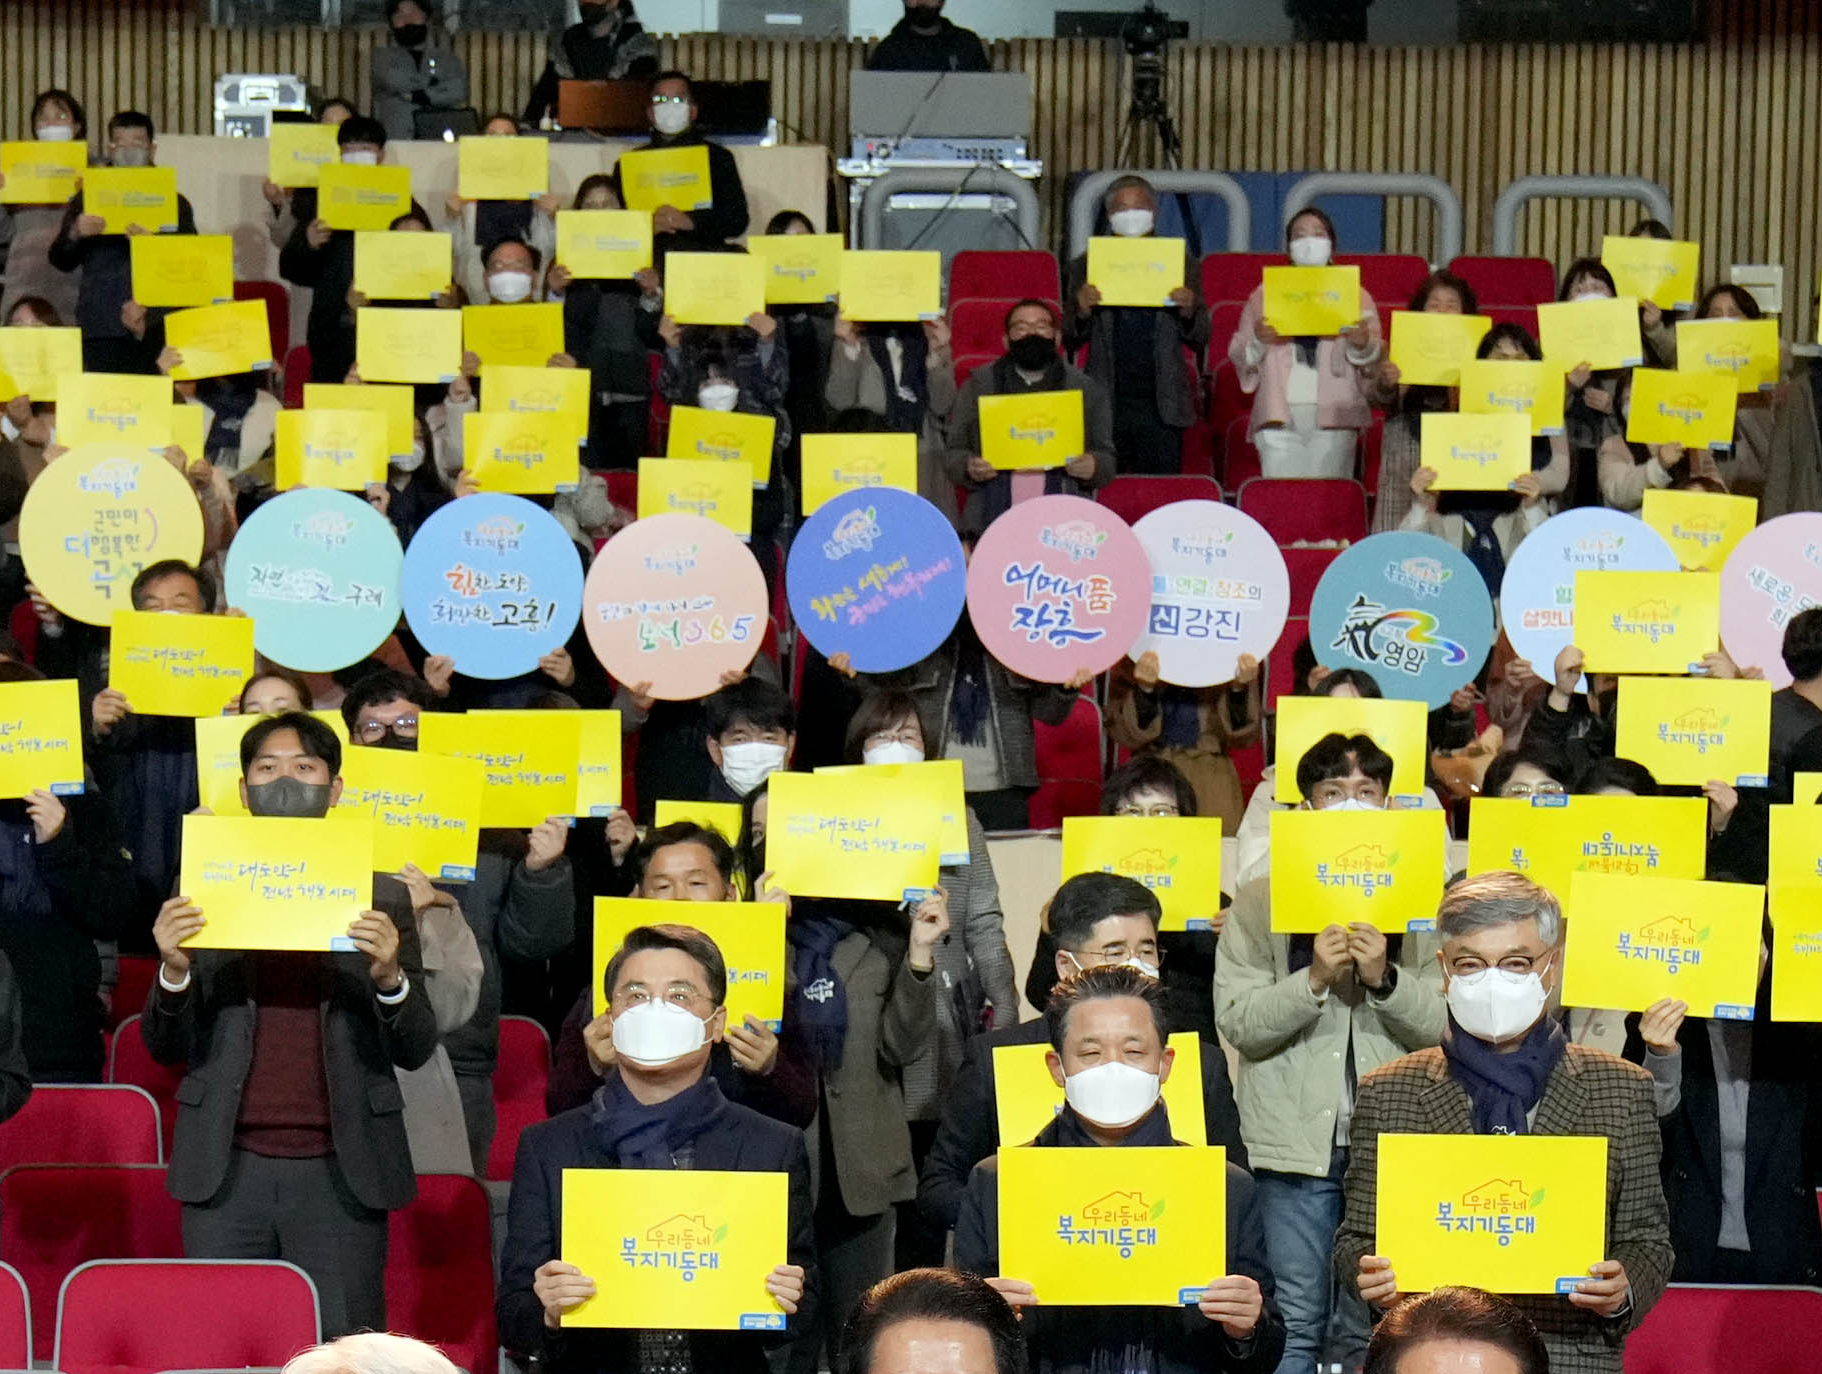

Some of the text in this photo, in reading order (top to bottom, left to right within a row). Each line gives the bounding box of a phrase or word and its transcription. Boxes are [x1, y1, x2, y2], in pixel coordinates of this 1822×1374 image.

[1004, 561, 1084, 602] 어머니
[1746, 564, 1795, 605] 새로운
[1011, 601, 1105, 647] 장흥
[1522, 608, 1575, 629] 살맛나
[1383, 640, 1427, 674] 영암
[1582, 832, 1659, 867] 복지기동대
[1317, 864, 1393, 897] 복지기동대
[1618, 932, 1702, 974] 복지기동대
[1091, 1208, 1147, 1225] 우리동네
[1471, 1194, 1527, 1212] 우리동네
[655, 1228, 710, 1251] 우리동네
[1057, 1216, 1157, 1259] 복지기동대
[1436, 1202, 1536, 1247] 복지기동대
[621, 1237, 719, 1282] 복지기동대
